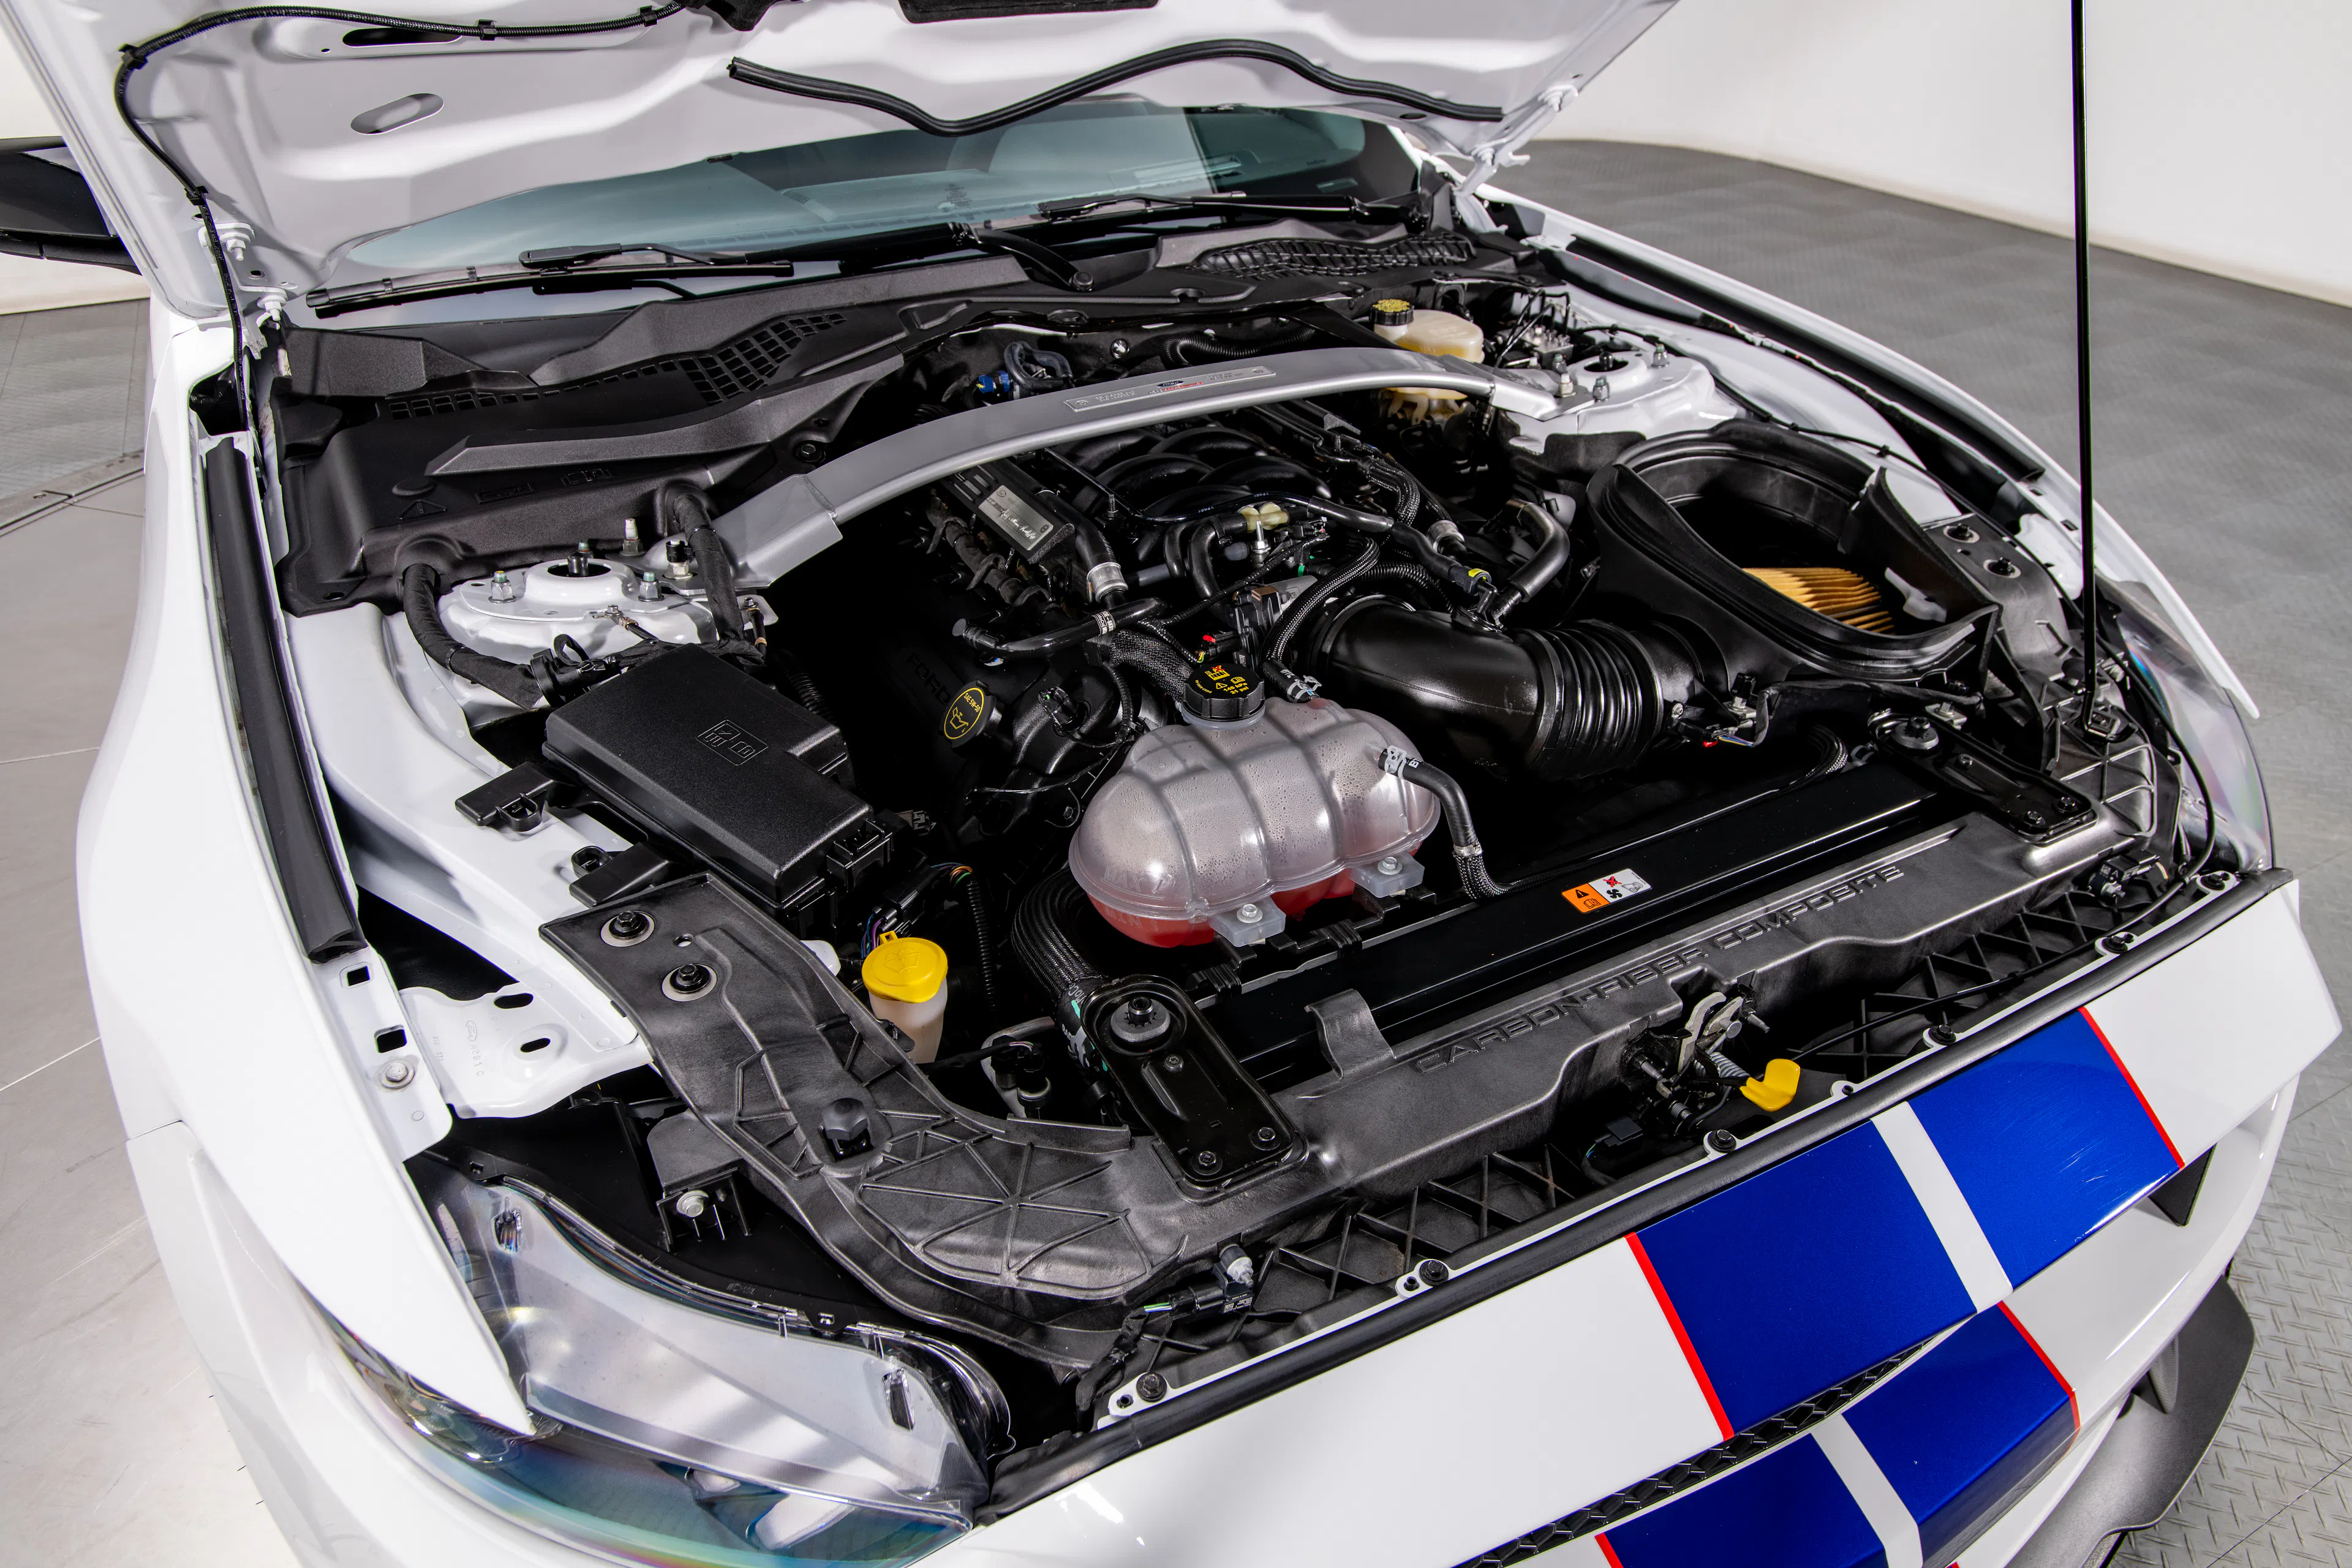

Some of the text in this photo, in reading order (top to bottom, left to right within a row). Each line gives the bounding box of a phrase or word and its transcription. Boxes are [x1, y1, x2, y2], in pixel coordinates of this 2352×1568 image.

[907, 652, 951, 705] FORD
[963, 693, 981, 712] SAE 5W-50
[1102, 864, 1145, 893] MAX
[1415, 864, 1905, 1074] CARBON-FIBER COMPOSITE
